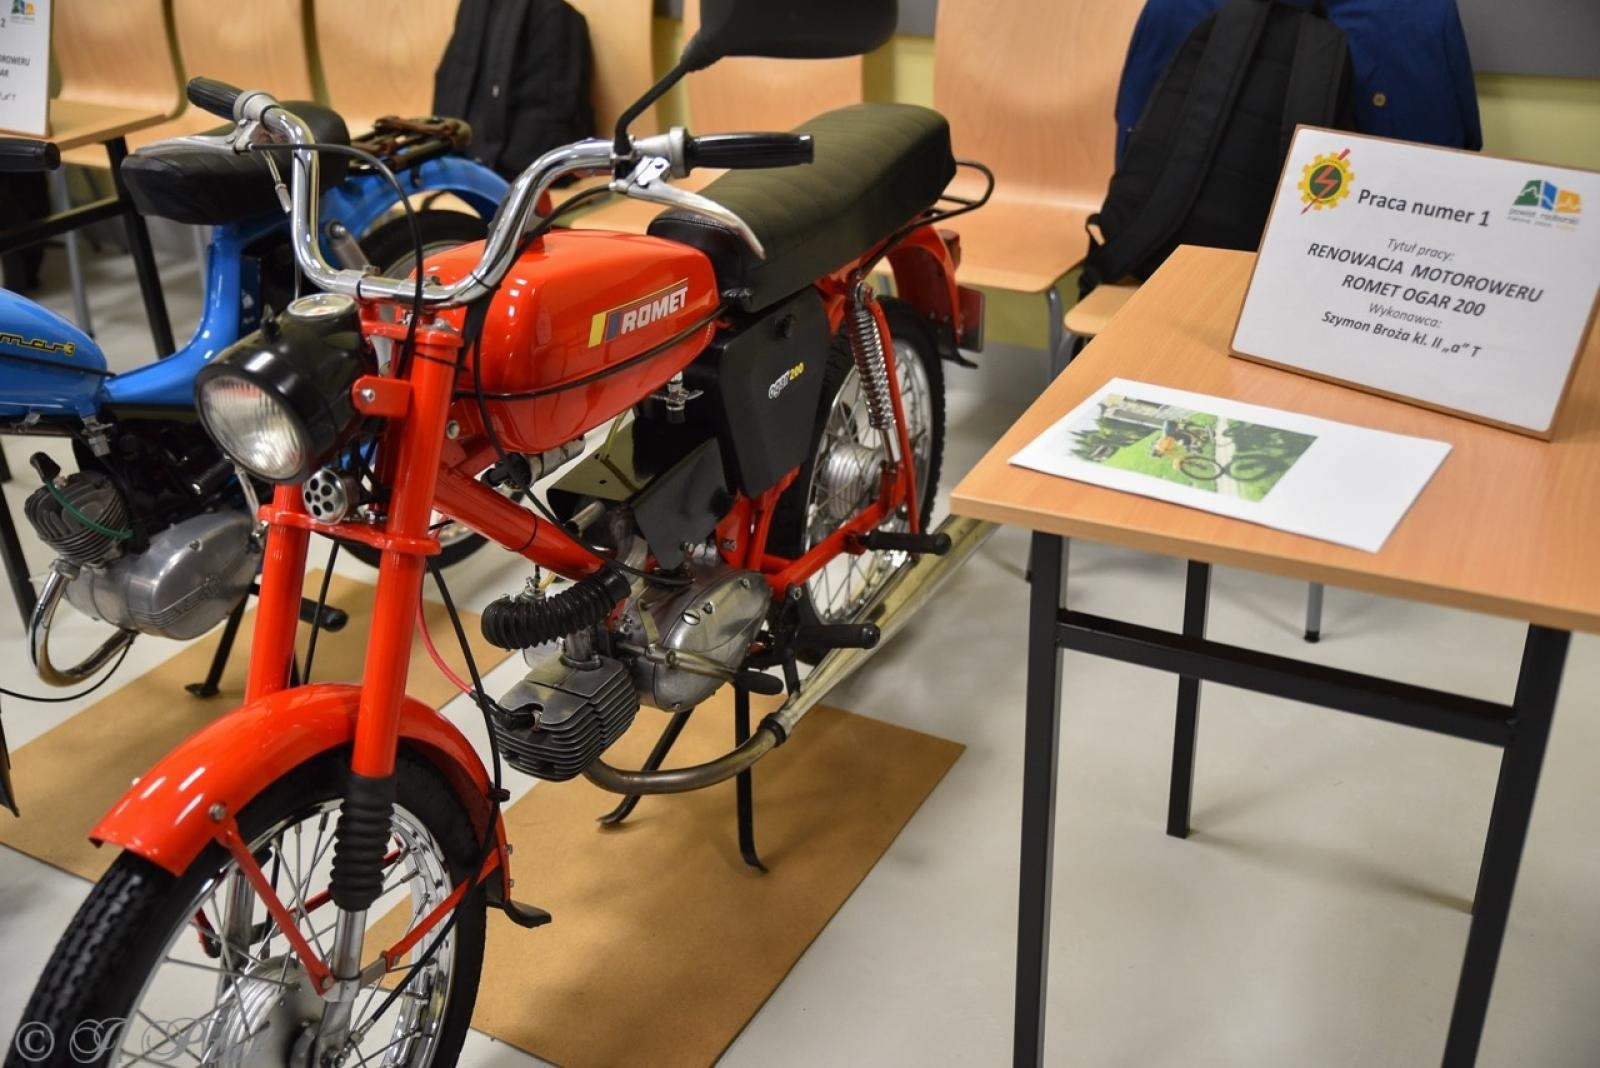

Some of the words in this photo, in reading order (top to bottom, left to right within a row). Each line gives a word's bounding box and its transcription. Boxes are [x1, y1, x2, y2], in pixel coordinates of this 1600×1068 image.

[1357, 188, 1407, 212] Praca
[1410, 200, 1476, 224] numer
[1478, 210, 1491, 227] 1
[1387, 238, 1417, 254] Tytuł
[1416, 246, 1455, 262] pracy:
[1307, 242, 1404, 275] RENOWACJA
[1410, 264, 1544, 303] MOTOROWERU
[620, 286, 688, 335] ROMET
[1341, 274, 1402, 298] ROMET
[1402, 287, 1451, 310] OGAR
[1452, 298, 1486, 317] 200
[1369, 302, 1443, 329] Wykonawca:
[1321, 311, 1371, 337] Szymon
[1373, 323, 1411, 342] Broża
[1412, 331, 1428, 346] kl.
[1471, 345, 1482, 358] T
